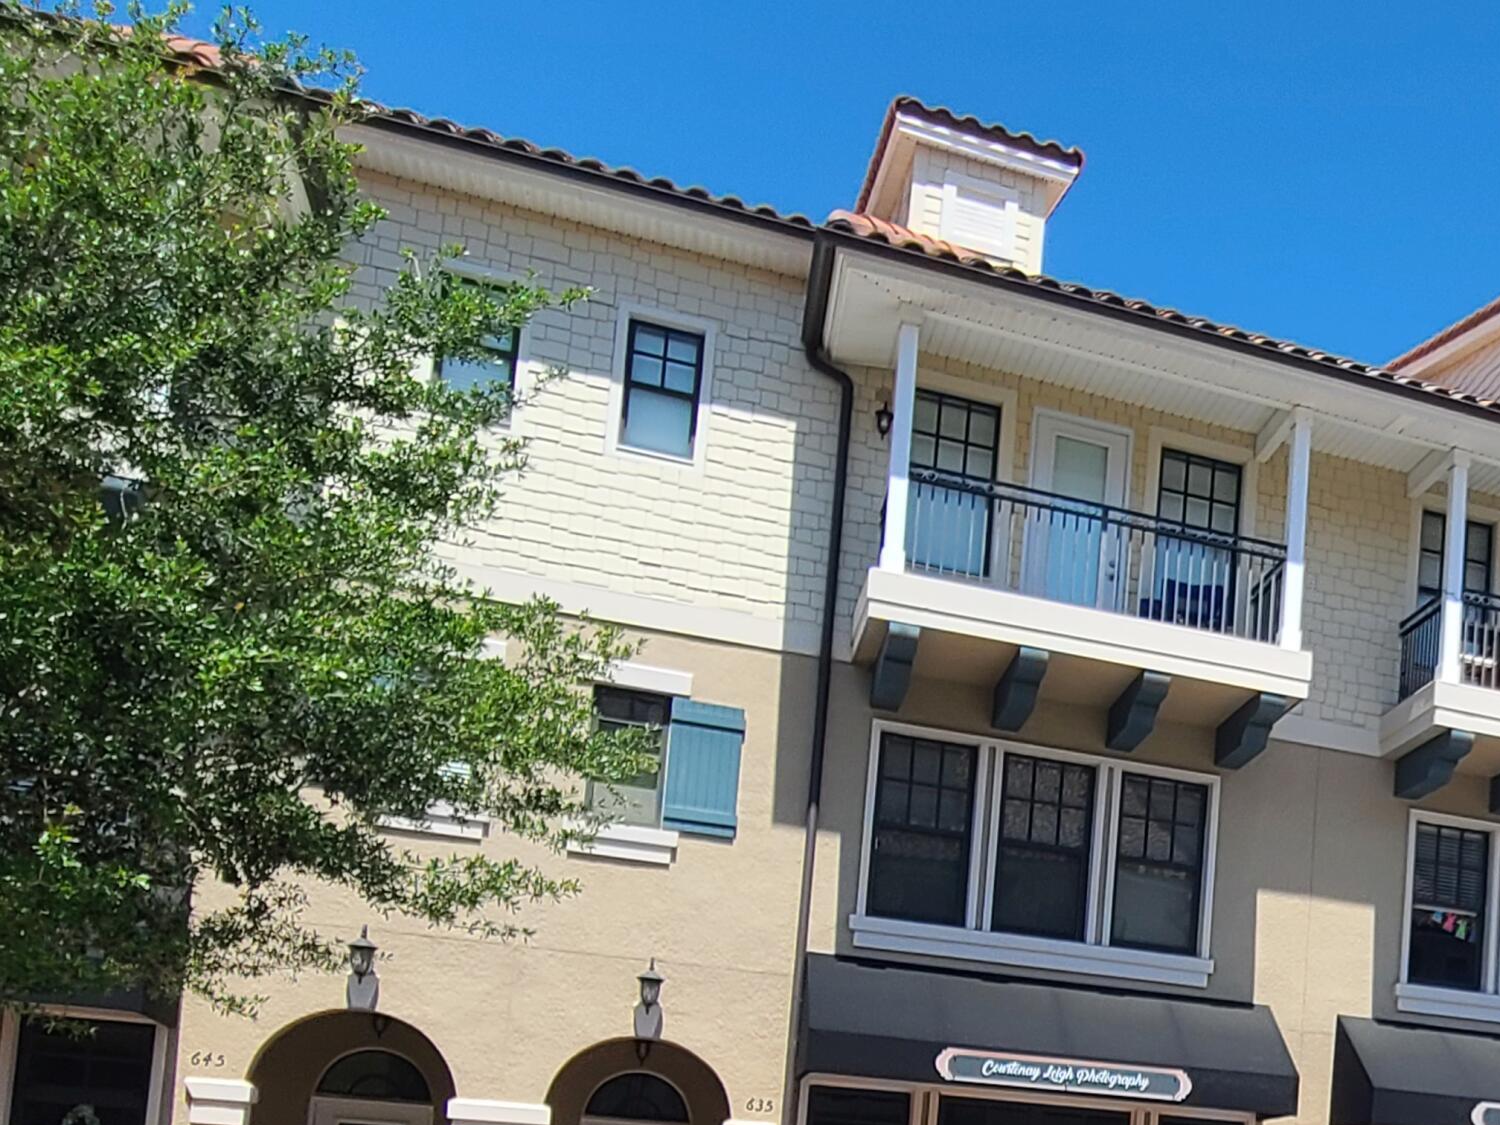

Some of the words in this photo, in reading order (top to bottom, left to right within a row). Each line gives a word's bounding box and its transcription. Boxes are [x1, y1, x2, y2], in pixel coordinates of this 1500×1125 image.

[191, 1051, 225, 1067] 645
[1043, 1065, 1075, 1084] Leigh
[1076, 1068, 1150, 1091] Photography
[746, 1097, 773, 1112] 635
